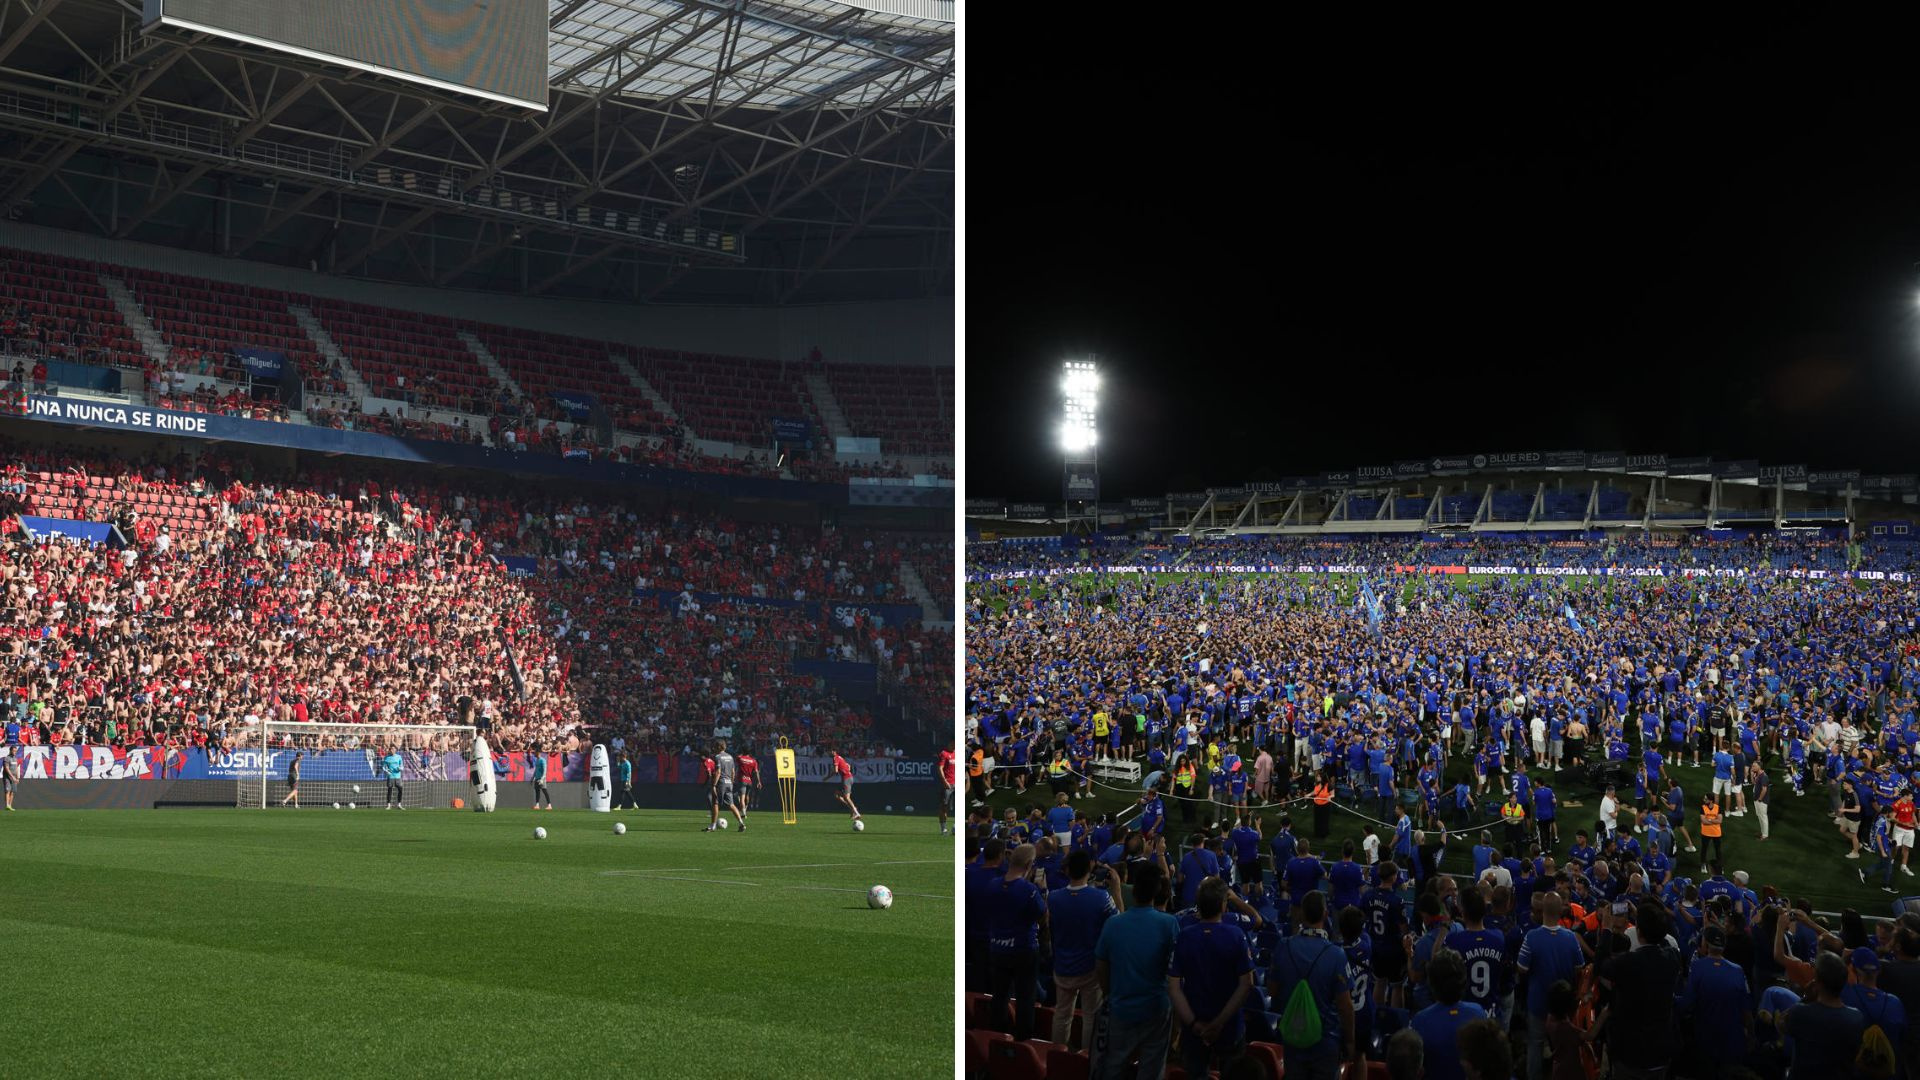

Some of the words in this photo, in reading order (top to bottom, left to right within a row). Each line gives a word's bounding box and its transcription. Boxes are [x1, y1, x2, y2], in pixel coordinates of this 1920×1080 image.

[66, 403, 128, 424] NUNCA
[131, 411, 152, 426] SE
[156, 413, 207, 433] RINDE
[1626, 454, 1666, 467] LUJISA
[1358, 466, 1393, 477] LUJISA
[1760, 466, 1805, 479] LUJISA
[1245, 483, 1281, 493] LUJISA
[1468, 566, 1518, 575] EUROGETA
[209, 752, 283, 768] osner
[782, 756, 790, 769] 5
[867, 762, 894, 777] SUR
[896, 761, 934, 775] osner
[1372, 910, 1385, 936] 5
[1470, 960, 1491, 999] 9
